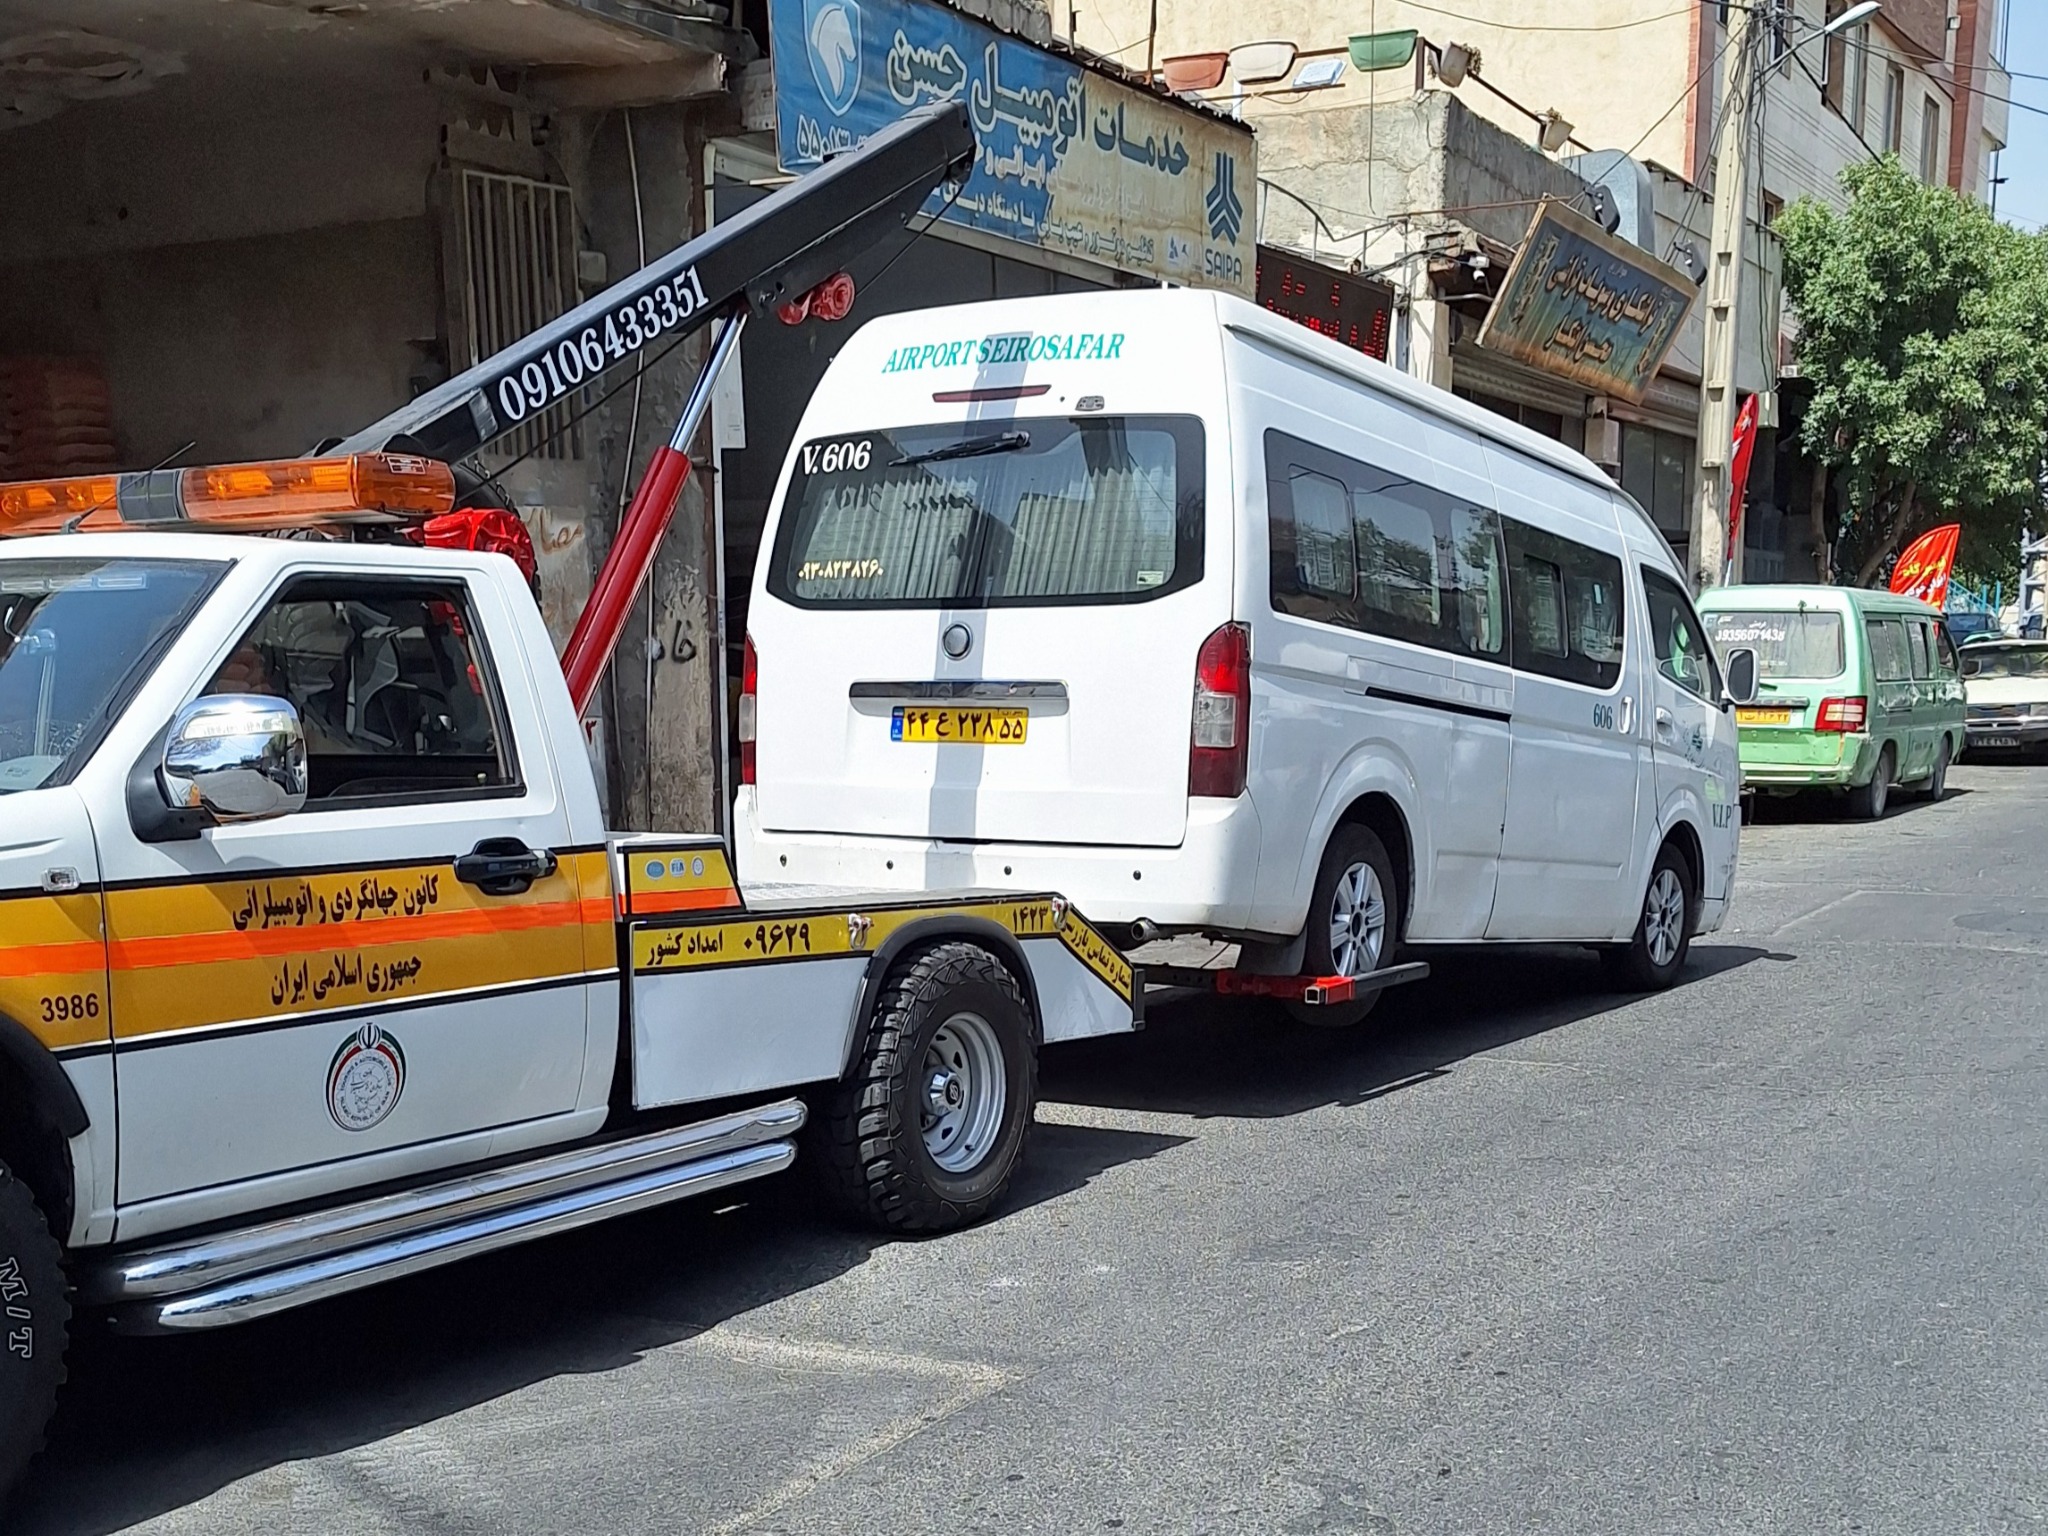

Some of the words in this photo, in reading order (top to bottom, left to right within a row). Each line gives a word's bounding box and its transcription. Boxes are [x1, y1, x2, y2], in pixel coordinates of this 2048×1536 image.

[970, 40, 1087, 153] اتومبیل
[1093, 102, 1190, 176] خدمات
[1204, 247, 1243, 284] SAIPA
[499, 264, 709, 421] 09106433351
[881, 339, 976, 374] AIRPORT
[803, 440, 872, 475] V.606
[1593, 703, 1613, 730] 606
[1712, 803, 1732, 829] V.I.P
[232, 882, 314, 931] اتومبیلرانی
[318, 895, 327, 924] و
[330, 877, 398, 922] جهانگردی
[402, 873, 439, 915] کانون
[1013, 904, 1049, 933] ۱۴۲۳
[646, 931, 684, 966] کشور
[687, 928, 723, 955] امداد
[744, 922, 811, 955] ۰۹۶۲۹
[366, 955, 422, 993] جمهوری
[1086, 945, 1111, 968] تماس
[271, 959, 309, 1006] ایران
[313, 953, 362, 1000] اسلامی
[1111, 964, 1131, 990] شماره
[41, 993, 100, 1024] 3986
[0, 1256, 33, 1358] M/T
